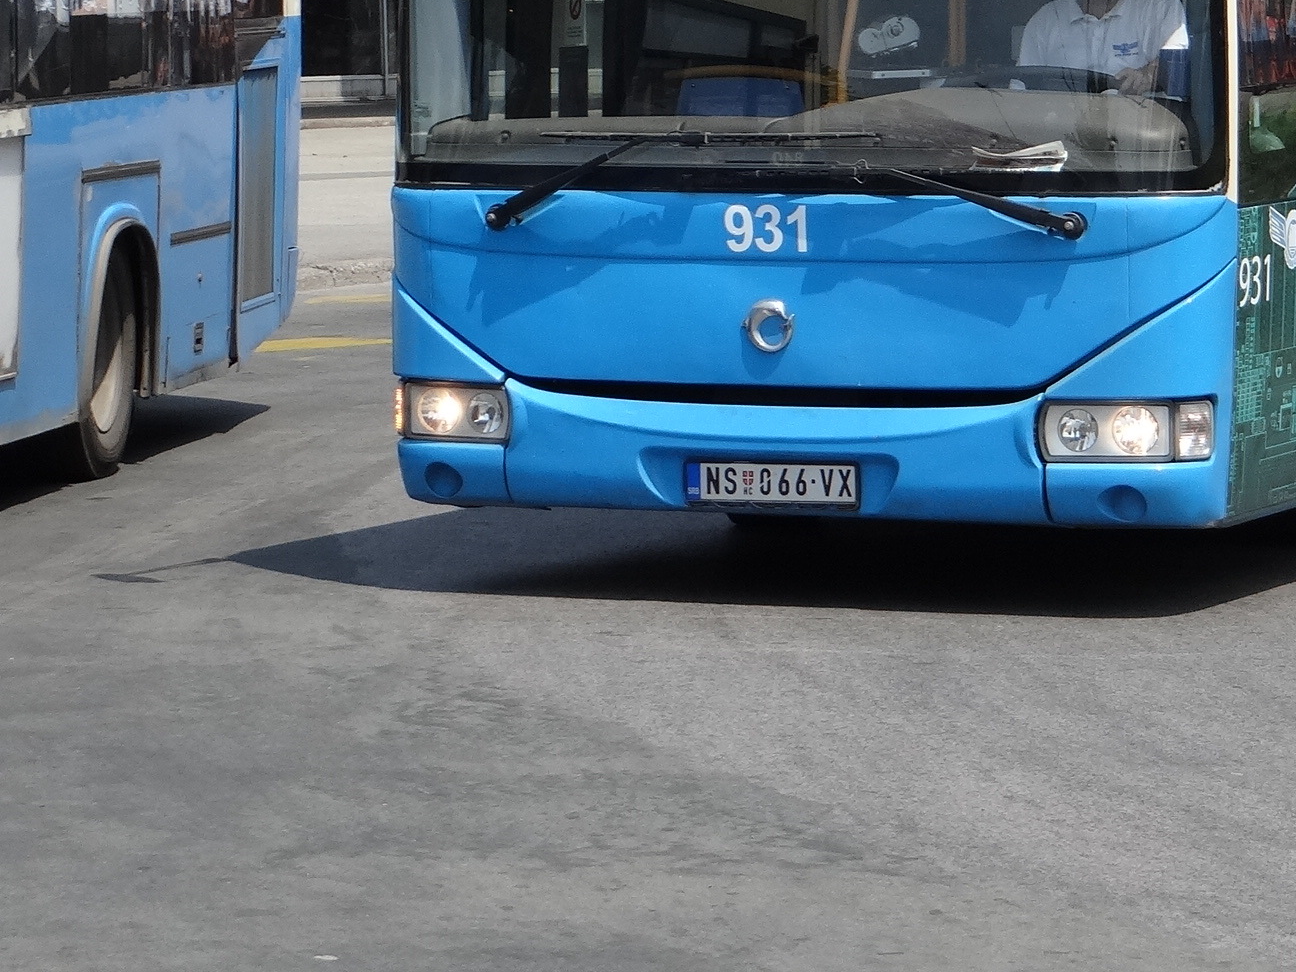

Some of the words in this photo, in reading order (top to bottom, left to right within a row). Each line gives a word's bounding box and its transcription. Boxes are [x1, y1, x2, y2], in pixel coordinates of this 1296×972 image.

[724, 203, 808, 253] 931
[1239, 254, 1271, 308] 931
[706, 466, 738, 495] NS
